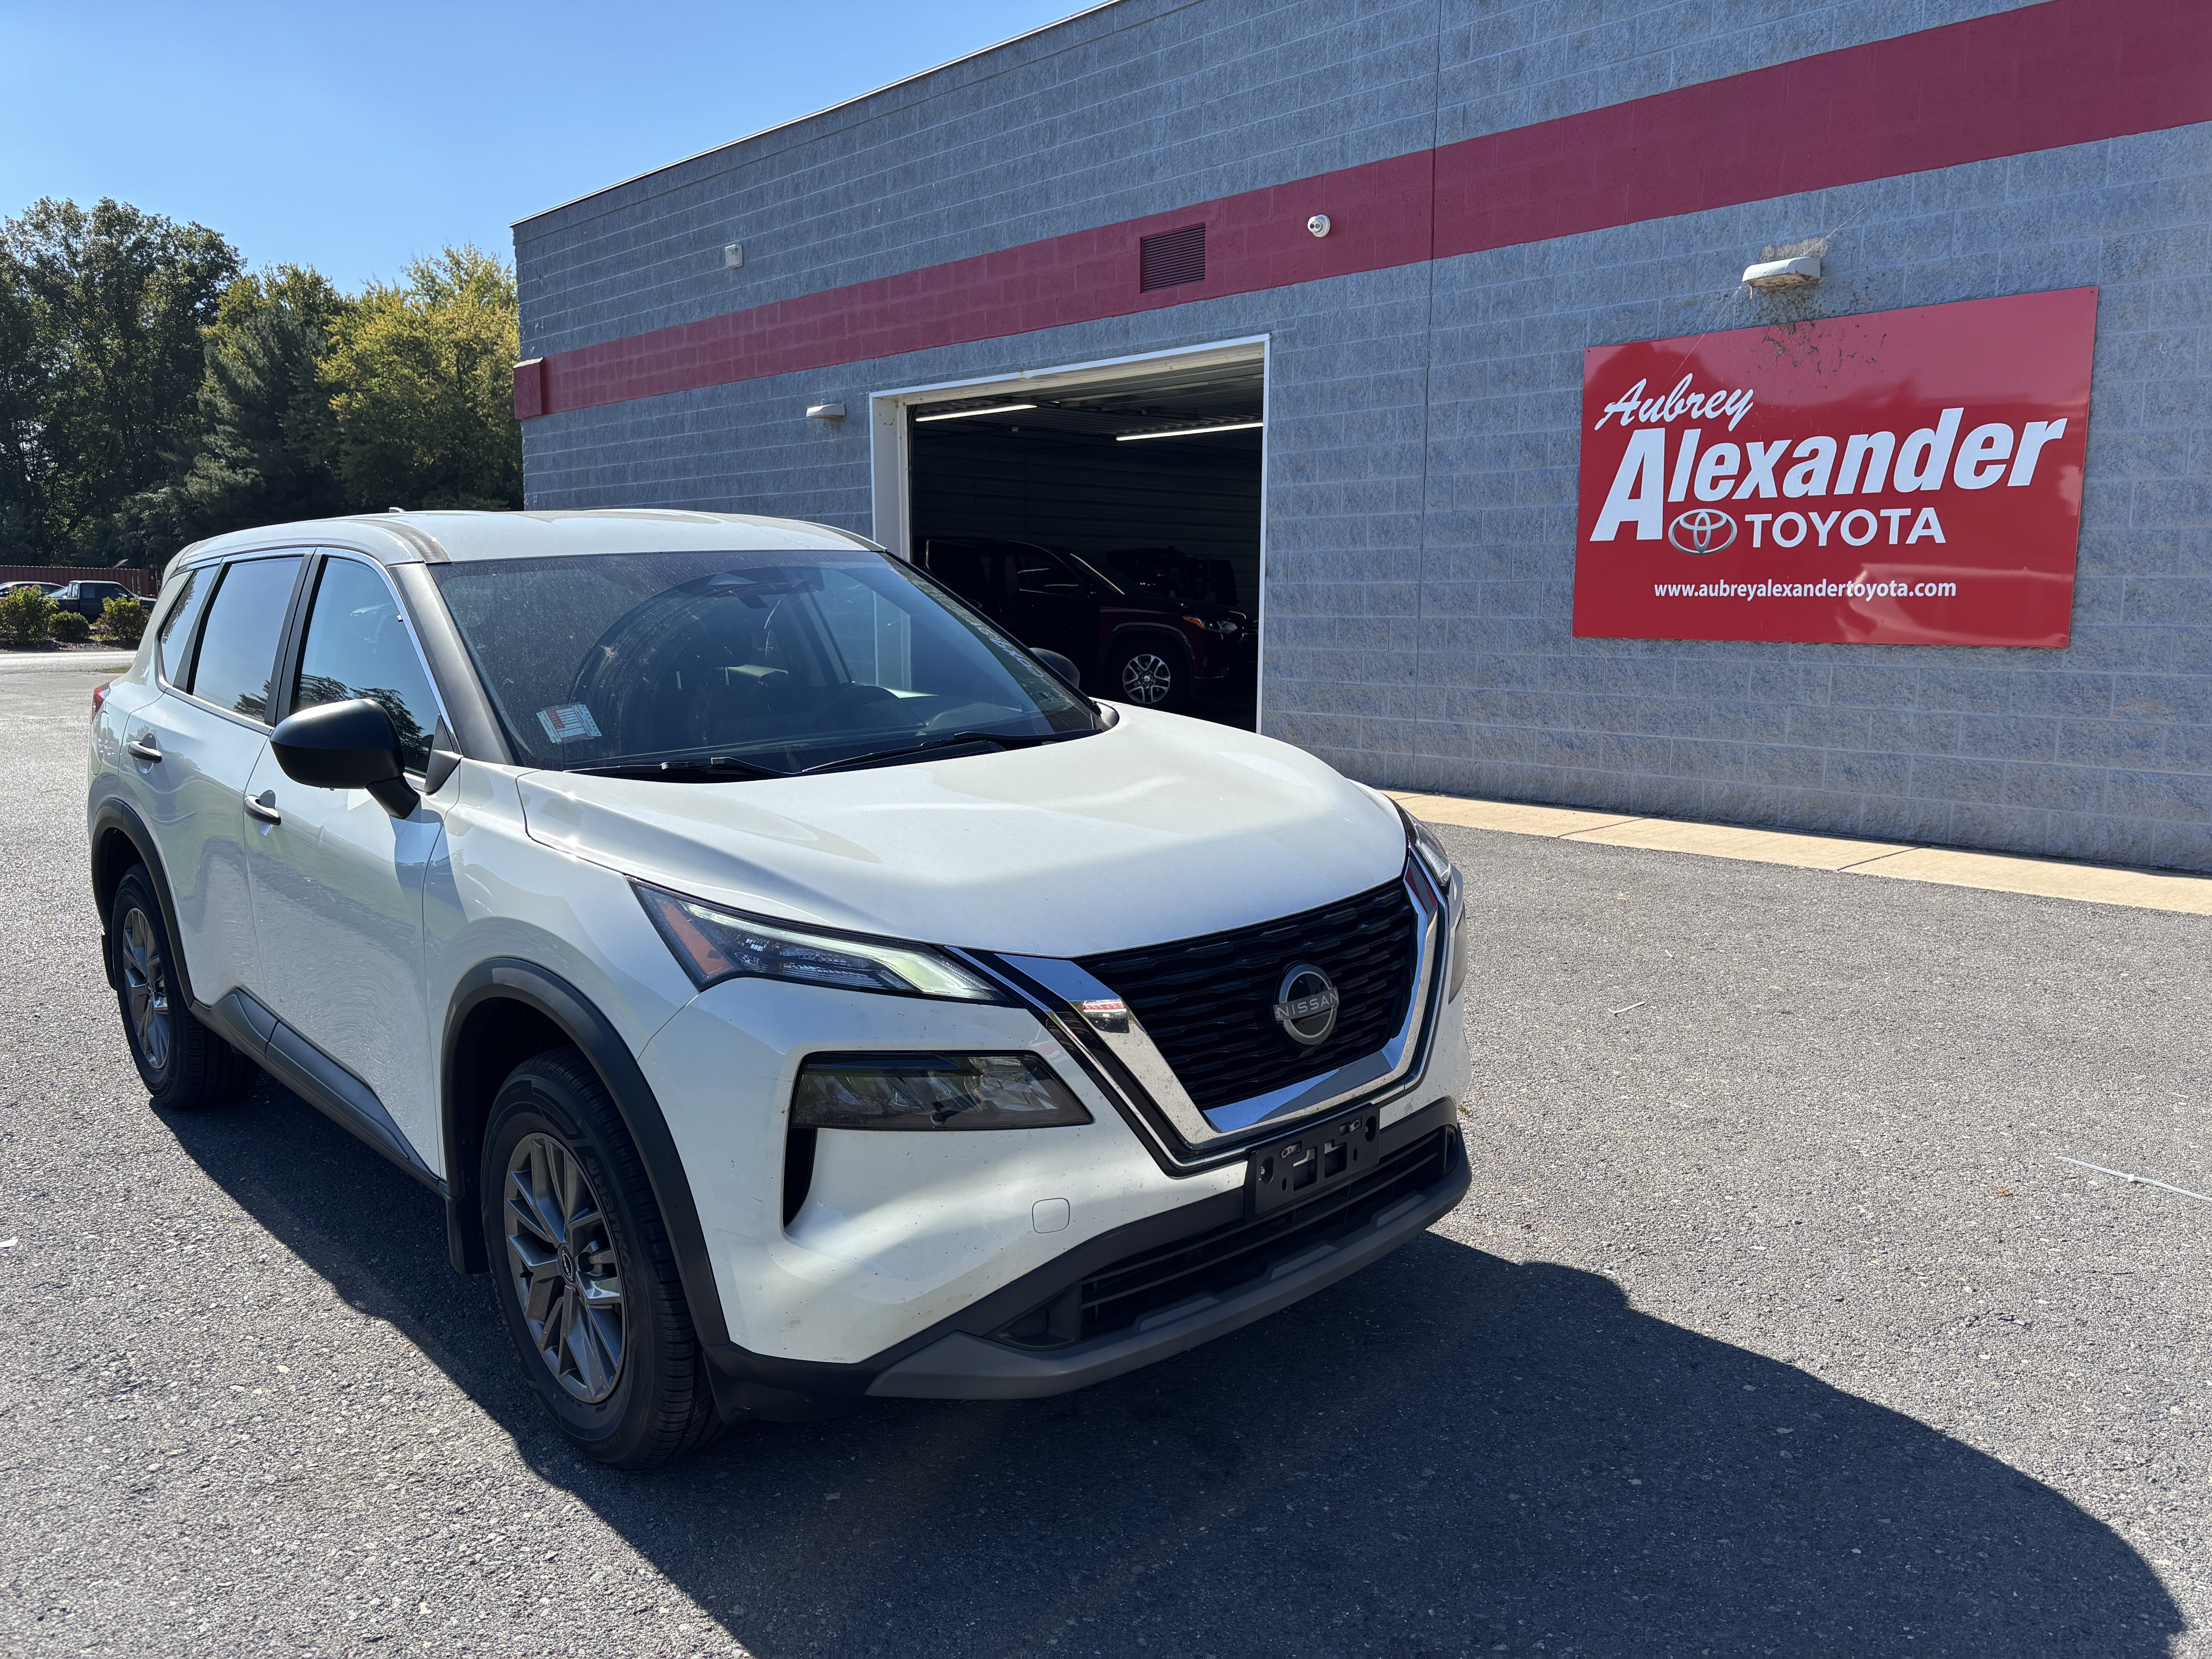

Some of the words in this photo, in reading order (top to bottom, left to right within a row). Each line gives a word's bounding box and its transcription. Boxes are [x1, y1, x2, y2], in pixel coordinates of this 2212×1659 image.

[1594, 373, 1753, 432] Aubrey
[1589, 407, 2068, 541] Alexander
[1745, 507, 1946, 548] TOYOTA
[1654, 579, 1956, 602] www.aubreyalexandertoyota.com
[1277, 990, 1339, 1017] NISSAN
